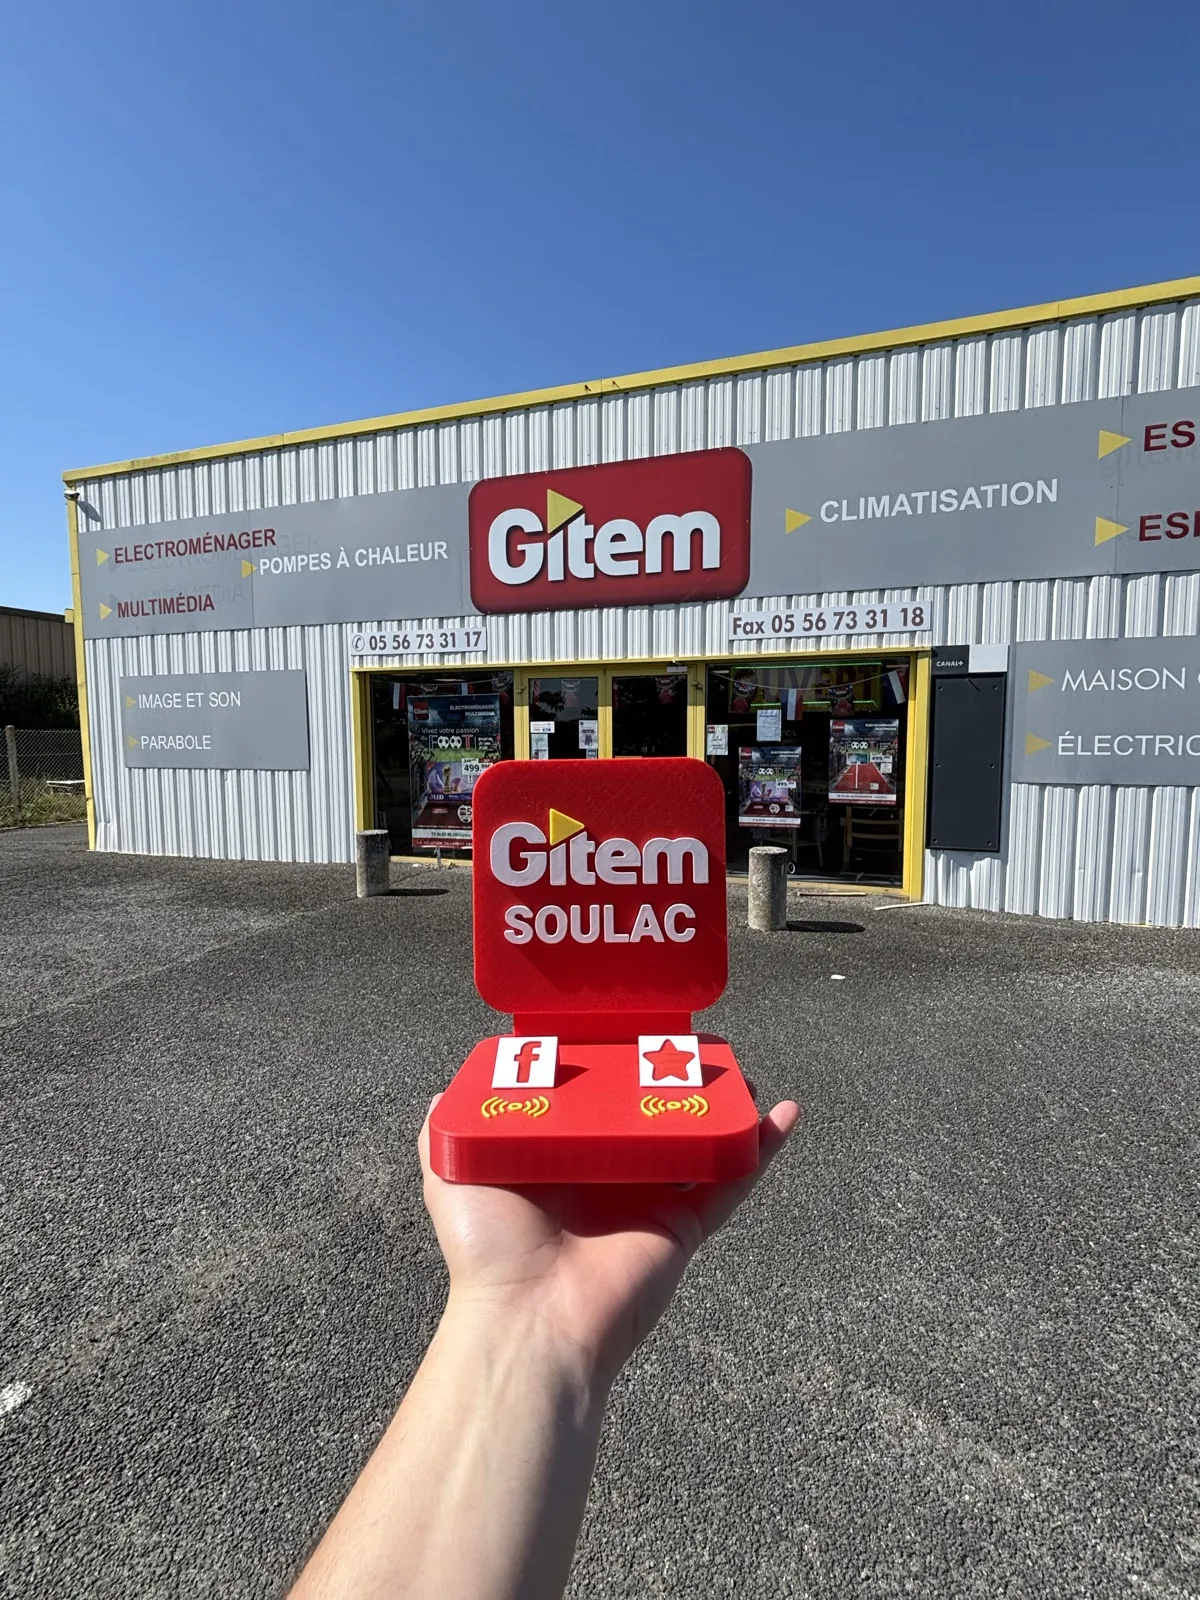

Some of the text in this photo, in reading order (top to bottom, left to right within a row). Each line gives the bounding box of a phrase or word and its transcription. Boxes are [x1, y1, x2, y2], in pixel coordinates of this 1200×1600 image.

[819, 478, 1058, 523] CLIMATISATION
[114, 528, 276, 564] ELECTROMÉNAGER
[487, 489, 721, 585] Gitem
[259, 552, 332, 576] POMPES
[336, 546, 350, 569] À
[355, 541, 448, 567] CHALEUR
[117, 592, 216, 619] MULTIMÉDIA
[732, 606, 925, 635] Fax 05 56 73 31 18
[369, 631, 482, 651] 05 56 73 31 17
[1061, 667, 1186, 691] MAISON
[138, 691, 241, 709] IMAGE ET SON
[141, 734, 212, 750] PARABOLE
[489, 808, 710, 888] Gitem
[503, 903, 697, 945] SOULAC
